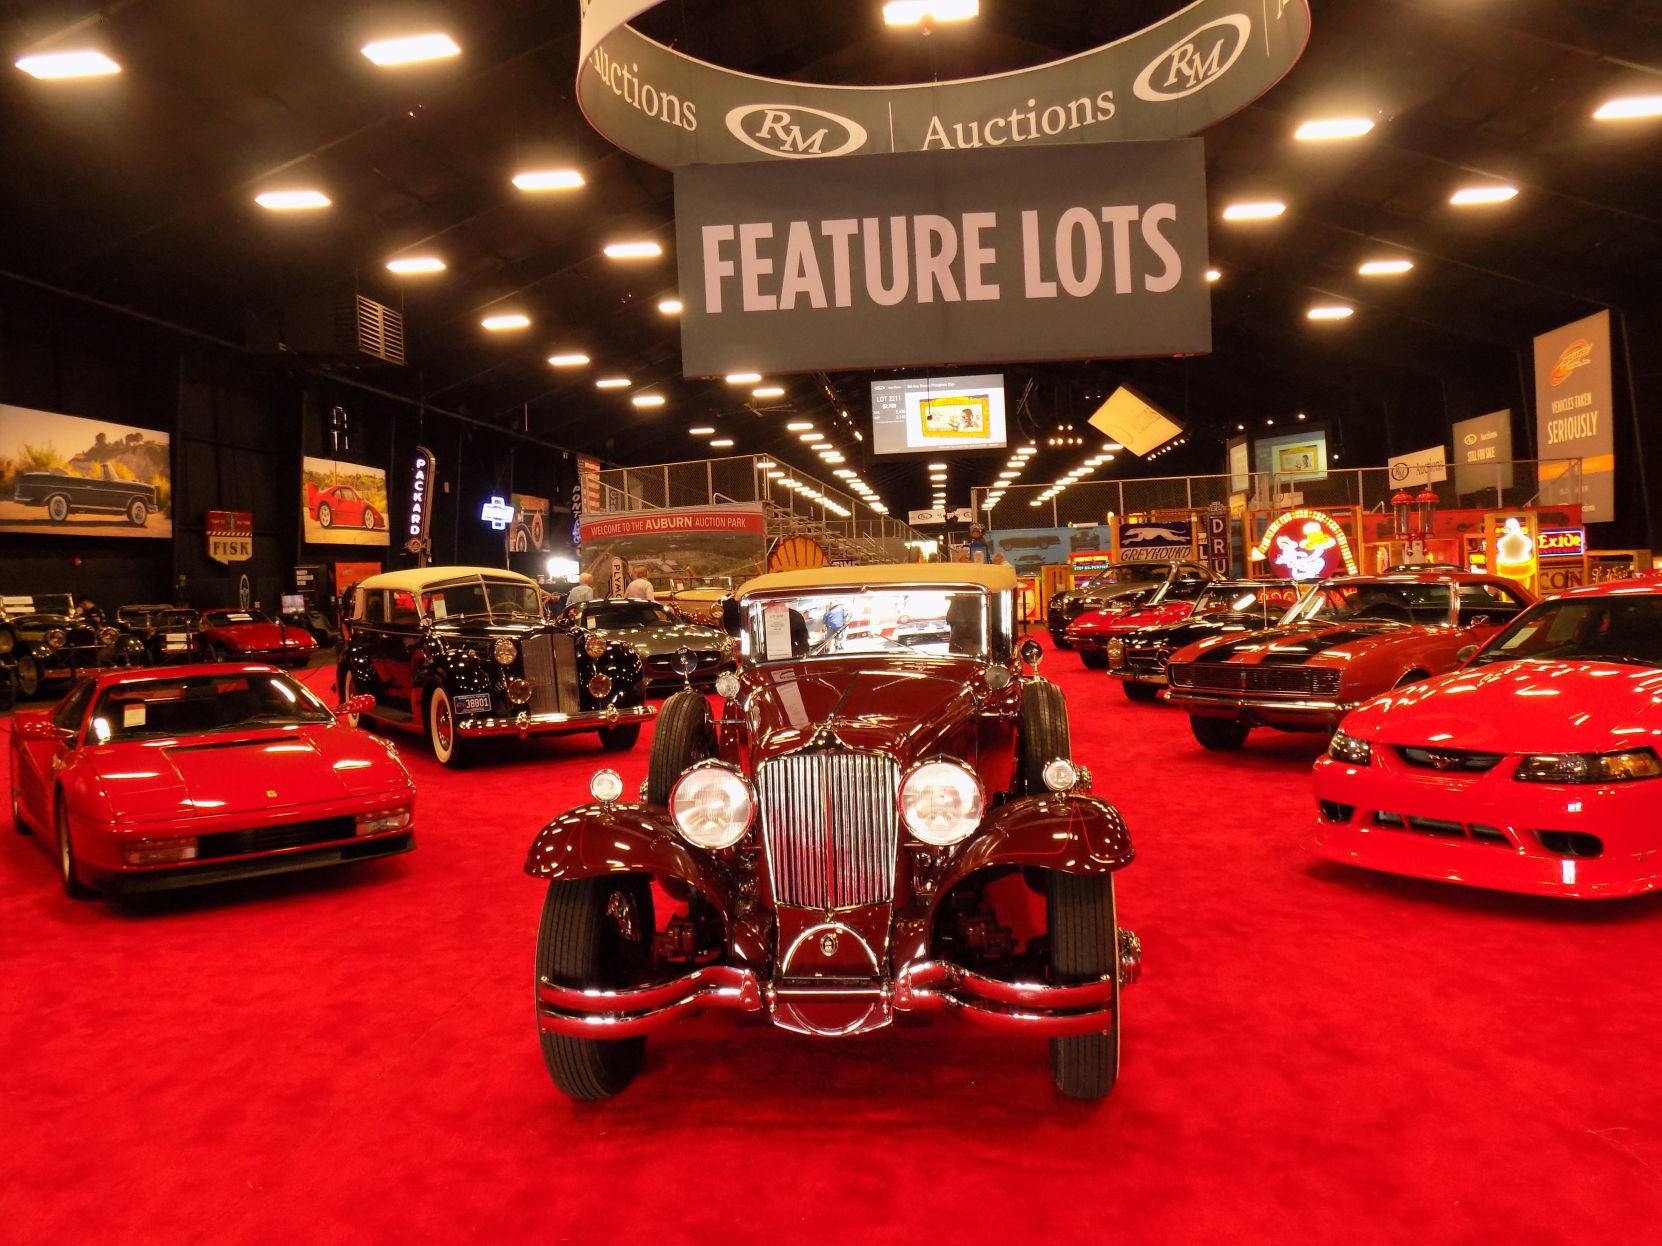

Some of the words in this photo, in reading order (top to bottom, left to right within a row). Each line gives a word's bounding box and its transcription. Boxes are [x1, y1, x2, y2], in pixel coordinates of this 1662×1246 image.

[1164, 39, 1225, 89] RM
[756, 109, 828, 154] RM
[920, 90, 1116, 151] Auctions
[702, 211, 1001, 314] FEATURE
[1021, 203, 1182, 298] LOTS
[1551, 396, 1574, 414] VEHICLES
[1574, 392, 1592, 408] TAKEN
[1547, 411, 1598, 445] SERIOUSLY
[410, 459, 426, 535] PACKARD
[591, 525, 621, 537] WELCOME
[622, 524, 631, 532] TO
[632, 521, 644, 531] THE
[645, 516, 693, 531] AUBURN
[695, 517, 726, 528] AUCTION
[727, 518, 746, 528] PARK
[1537, 533, 1581, 549] Exide
[213, 541, 249, 556] FISK
[1120, 546, 1192, 562] GREYHOUND
